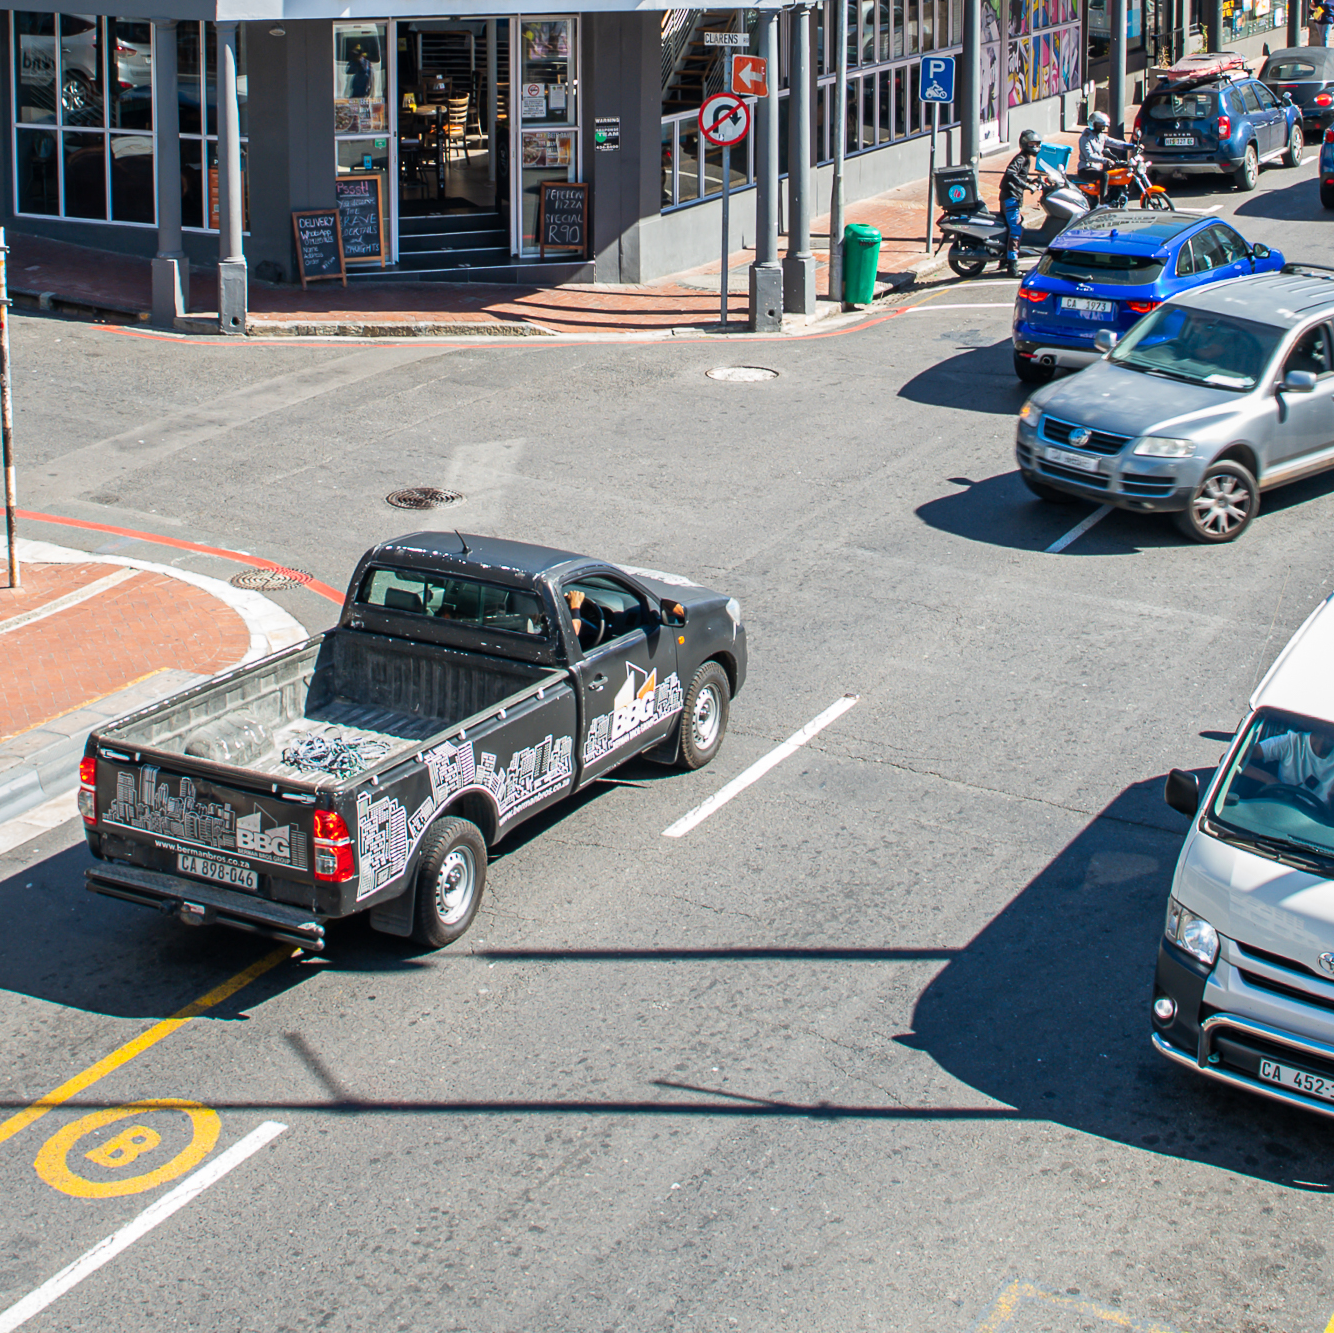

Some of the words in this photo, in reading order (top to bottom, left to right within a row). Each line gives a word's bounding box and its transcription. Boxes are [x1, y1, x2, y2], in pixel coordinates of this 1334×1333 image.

[705, 33, 738, 44] CLARENS
[930, 60, 945, 78] P
[555, 199, 583, 209] PIZZA
[299, 216, 334, 228] DELIVERY
[545, 213, 584, 224] SPECIAL
[549, 225, 580, 243] R90
[1067, 298, 1077, 307] CA
[1086, 300, 1107, 310] 1973
[614, 690, 655, 742] BBG
[237, 828, 291, 858] BBG
[155, 839, 250, 869] www.bermanbros.co.za
[238, 848, 258, 857] BERMAN
[259, 852, 272, 860] BROS
[273, 855, 291, 865] GROUP
[181, 855, 197, 873] CA
[202, 861, 254, 887] 898-046
[1262, 1061, 1281, 1081] CA
